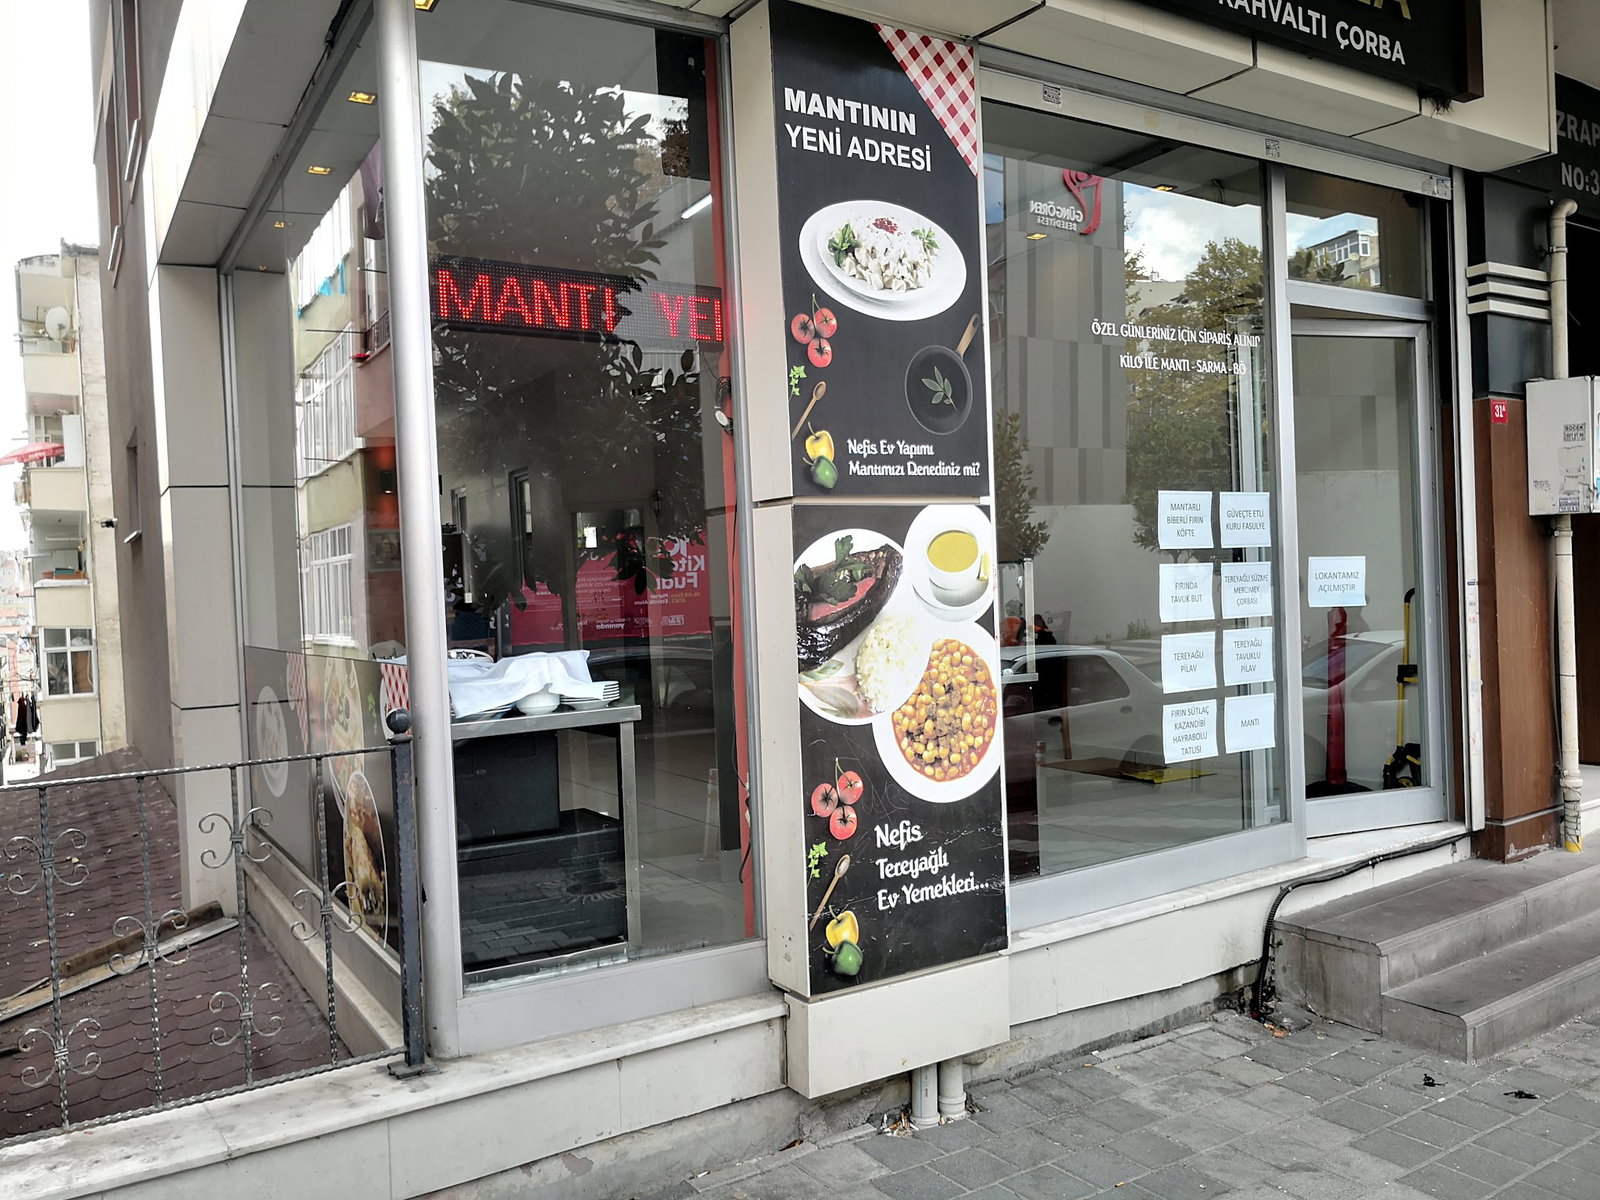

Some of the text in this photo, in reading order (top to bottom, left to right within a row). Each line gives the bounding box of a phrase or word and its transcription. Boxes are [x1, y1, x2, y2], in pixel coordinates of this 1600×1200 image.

[1218, 0, 1327, 39] AHVALTI
[1336, 21, 1406, 65] ÇORBA
[784, 87, 916, 135] MANTININ
[785, 123, 931, 172] YENİ ADRESİ
[438, 269, 615, 332] MANTI
[1091, 318, 1119, 336] ÖZEL
[1120, 321, 1177, 340] GÜNLERİNİZ
[1177, 325, 1198, 346] İÇİN
[1198, 328, 1232, 349] SİPARİŞ
[1119, 352, 1143, 369] KİLO
[1144, 353, 1160, 370] İLE
[1160, 358, 1190, 372] MANTI
[1196, 360, 1228, 374] SARMA
[847, 438, 935, 459] Nefis Ev Yapımı
[848, 460, 981, 477] Mantımızı Denediniz mi?
[1170, 503, 1201, 512] MANTARLI
[1166, 514, 1204, 525] BİBERLİ FIRIN
[1226, 508, 1252, 520] GÜVEÇTE
[1225, 521, 1265, 531] KURU FASULYE
[1176, 528, 1195, 538] KÖFTE
[1224, 573, 1269, 583] TEREYAĞLI SÜZME
[1314, 571, 1360, 580] LOKANTAMIZ
[1175, 581, 1198, 590] FIRINDA
[1318, 583, 1356, 593] AÇILMIŞTIR
[1170, 594, 1202, 604] TAVUK BUT
[1236, 597, 1258, 607] ÇORBASI
[1234, 638, 1263, 649] TEREYAĞLI
[1173, 650, 1204, 661] TEREYAĞLI
[1235, 652, 1261, 661] TAVUKLU
[1180, 664, 1198, 673] PİLAV
[1240, 664, 1257, 673] PİLAV
[1170, 706, 1210, 718] FIRIN SÜTLAÇ
[1174, 718, 1206, 730] KAZANDİBİ
[1240, 718, 1260, 728] MANTI
[1172, 732, 1208, 744] HAYRABOLU
[1181, 746, 1202, 756] TATLISI
[874, 820, 924, 851] Nefis
[875, 846, 949, 880] Tereyağlı
[877, 889, 900, 911] Ev
